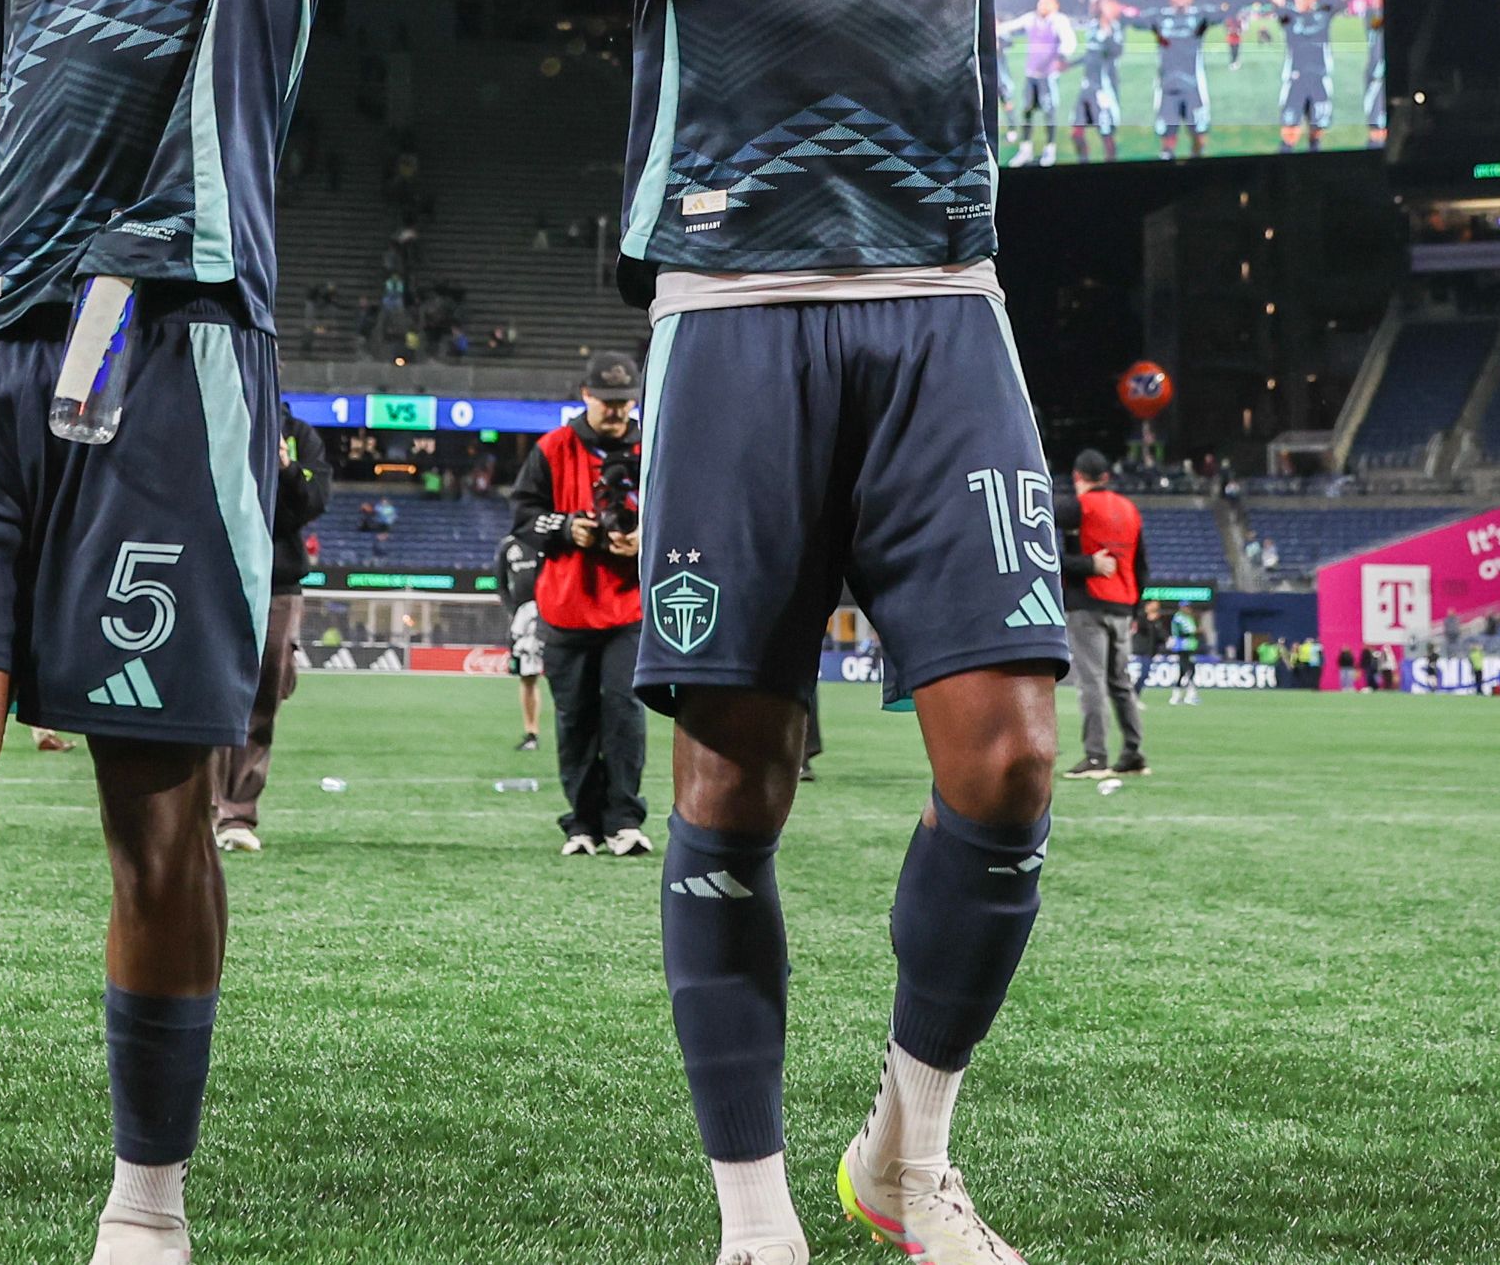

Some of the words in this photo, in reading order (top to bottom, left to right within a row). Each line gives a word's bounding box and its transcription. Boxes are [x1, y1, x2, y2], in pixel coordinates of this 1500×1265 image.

[685, 221, 721, 233] AEROREADY
[331, 397, 349, 424] 1
[384, 402, 417, 423] VS
[966, 468, 1061, 575] 15
[100, 541, 185, 654] 5
